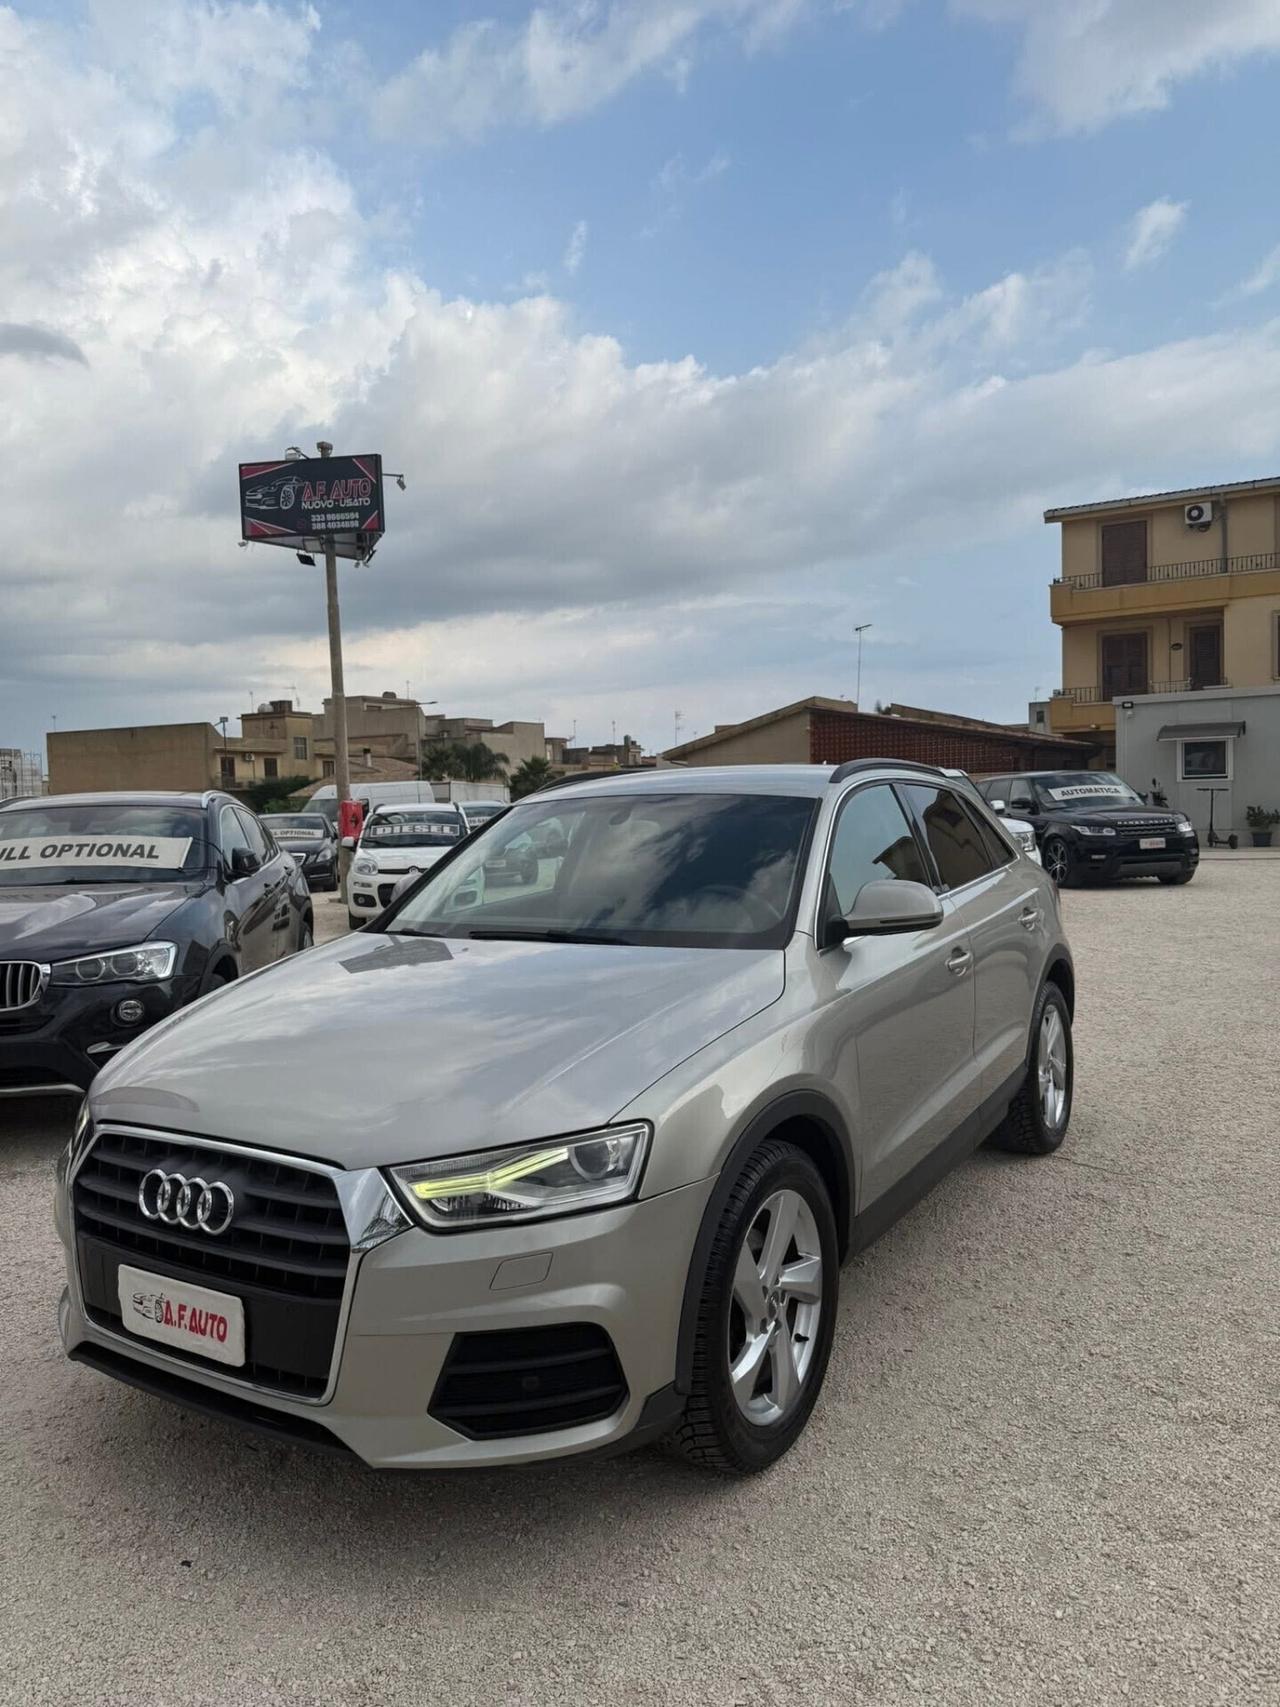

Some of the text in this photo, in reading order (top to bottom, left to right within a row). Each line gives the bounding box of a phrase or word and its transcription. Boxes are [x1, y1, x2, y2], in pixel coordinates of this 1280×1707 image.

[330, 478, 371, 499] AUTO
[301, 500, 334, 510] NUOVO
[340, 497, 371, 507] USATO
[1061, 787, 1121, 797] AUTOMATICA
[375, 825, 455, 835] DIESEL
[39, 843, 160, 859] OPTIONAL
